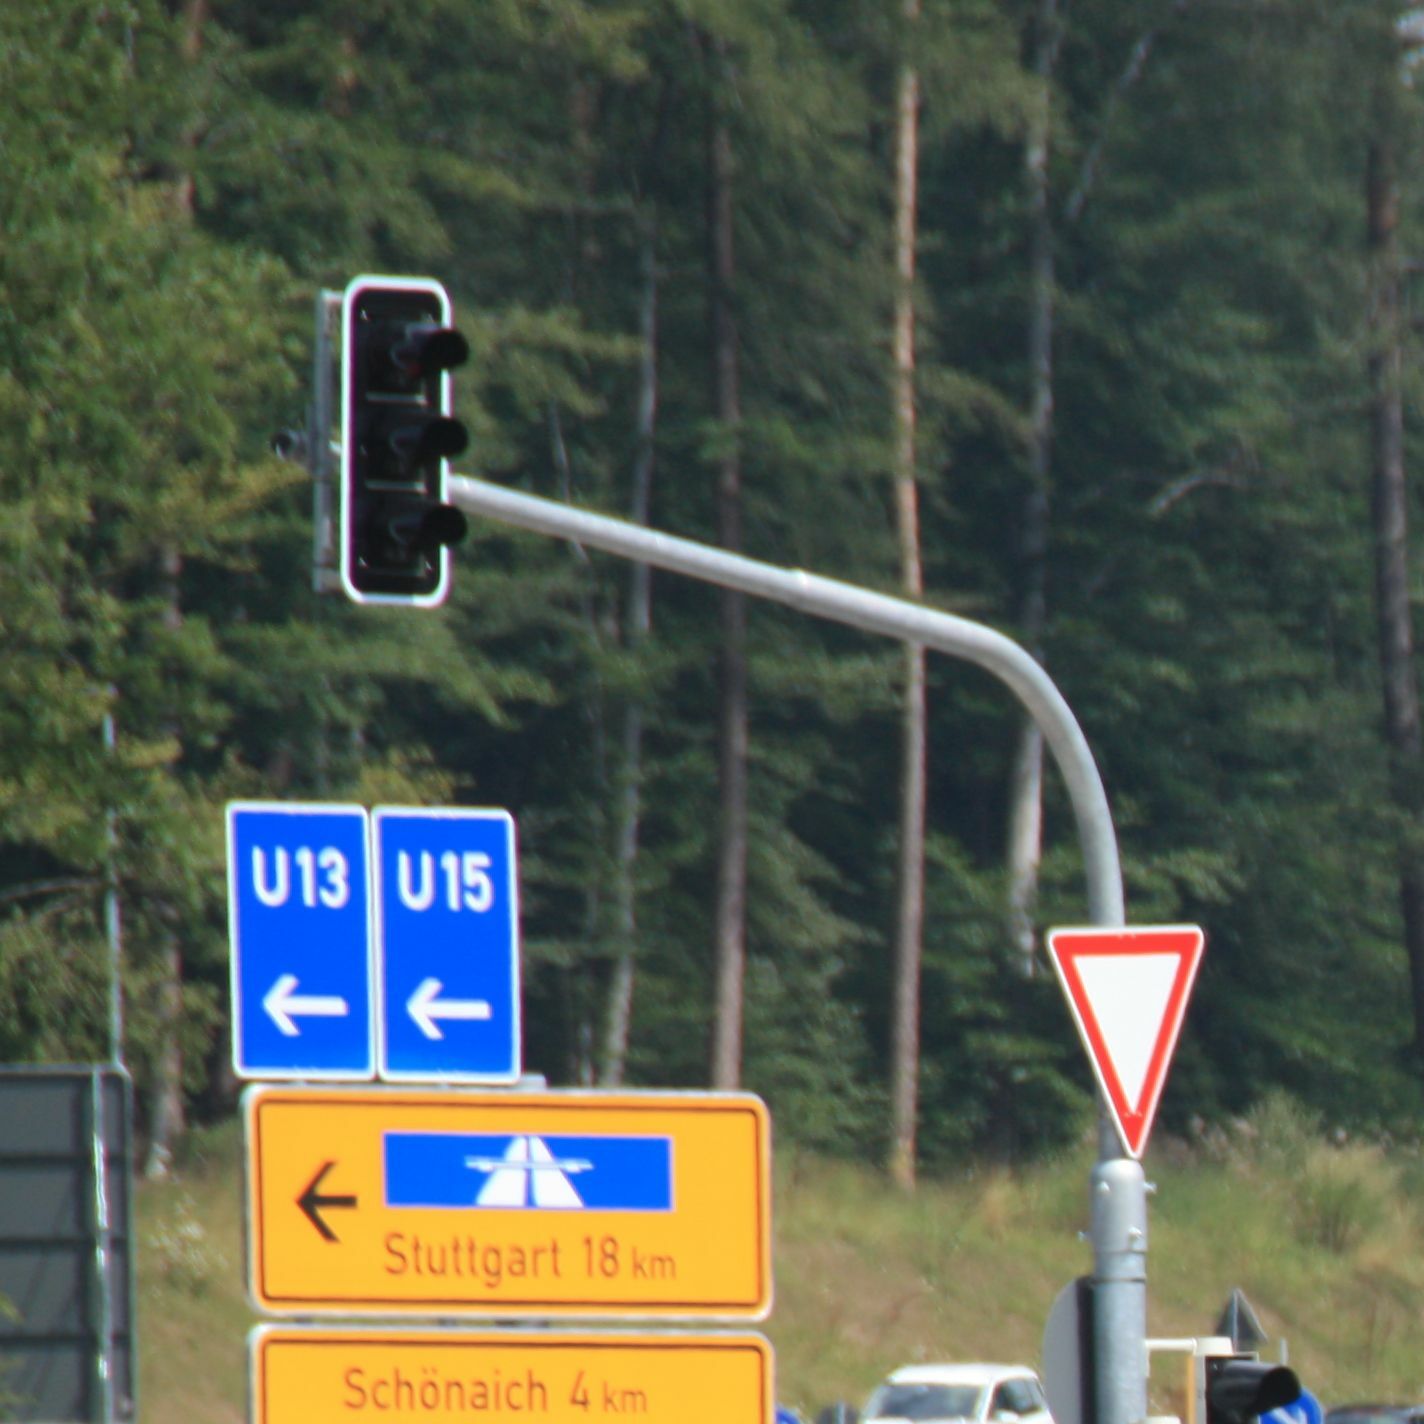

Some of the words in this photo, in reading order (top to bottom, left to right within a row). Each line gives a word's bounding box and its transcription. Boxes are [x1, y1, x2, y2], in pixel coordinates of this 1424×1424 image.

[252, 846, 349, 909] U13
[398, 849, 493, 913] U15
[384, 1231, 561, 1289] Stuttgart
[582, 1234, 620, 1280] 18
[631, 1245, 677, 1281] km
[342, 1366, 548, 1414] Schönaich
[569, 1369, 591, 1413] 4
[602, 1381, 648, 1414] km
